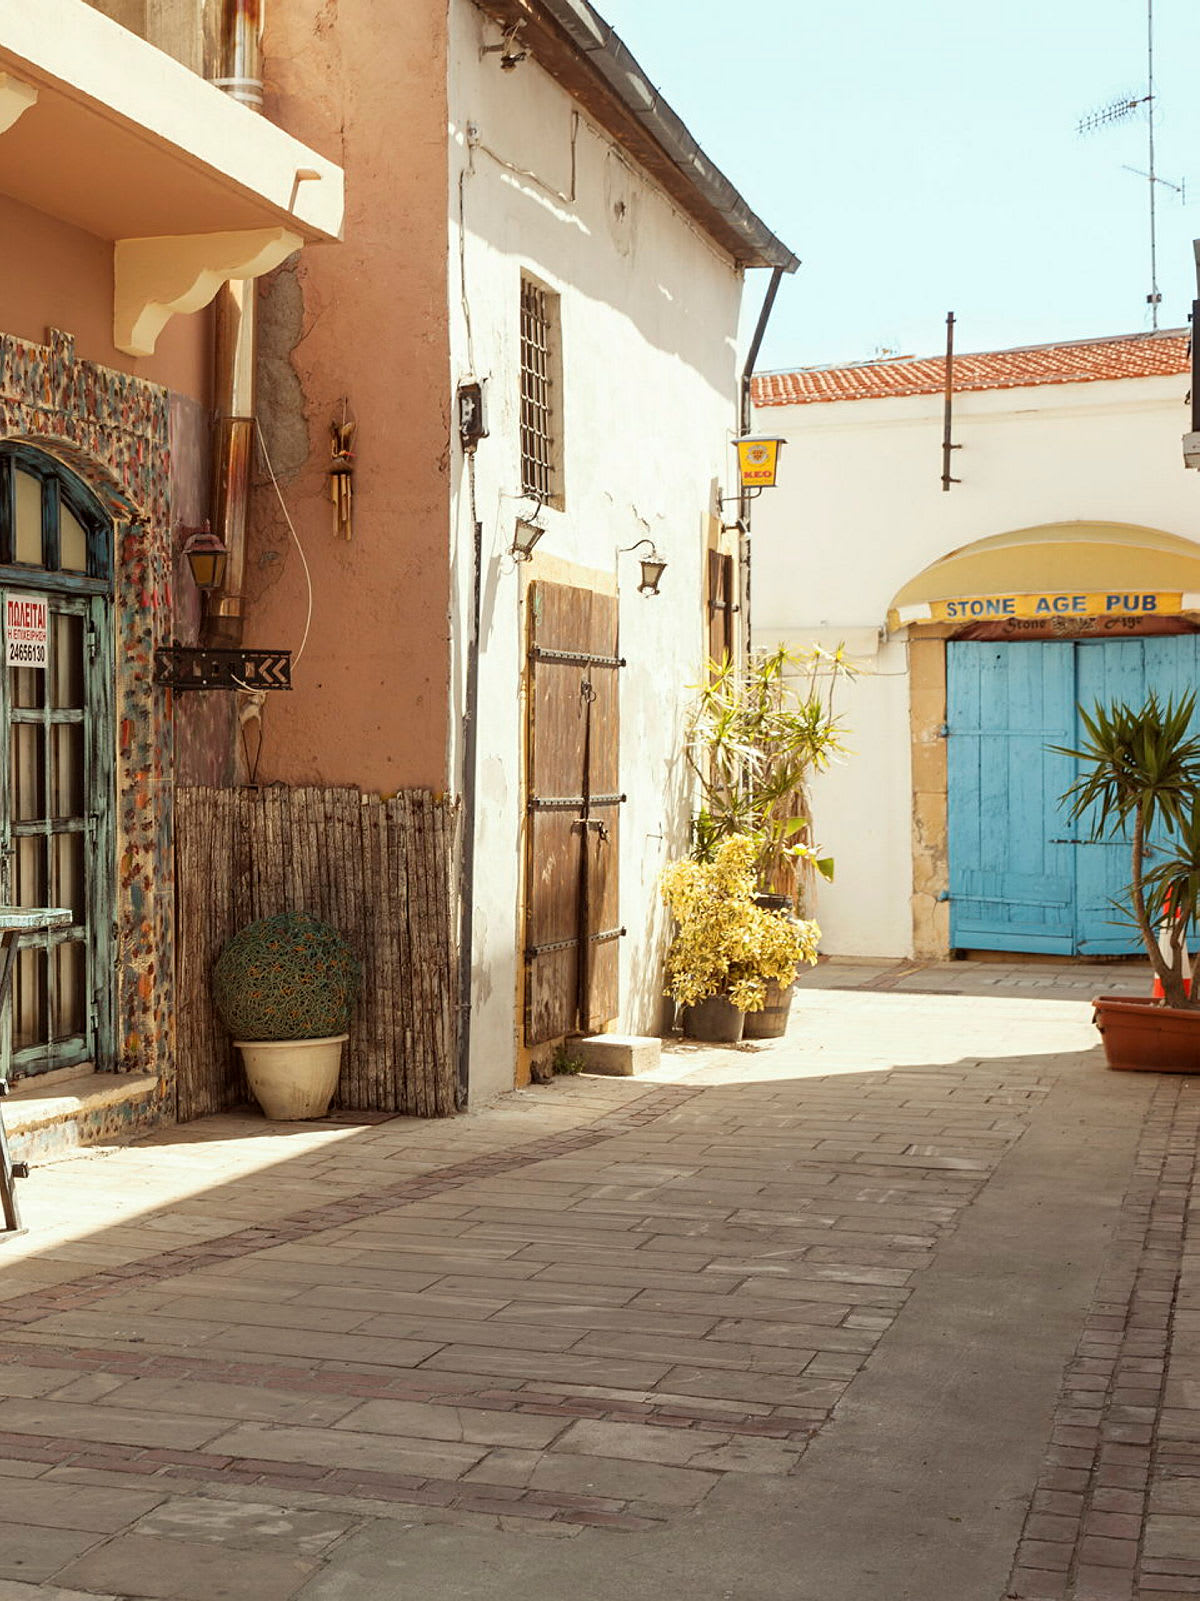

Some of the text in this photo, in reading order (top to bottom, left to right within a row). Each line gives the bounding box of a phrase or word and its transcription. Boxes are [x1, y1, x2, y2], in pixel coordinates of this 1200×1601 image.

[744, 470, 772, 478] KEO
[7, 600, 46, 629] ΠΩΛΕΙΤΑΙ
[947, 594, 1158, 617] STONE AGE PUB
[10, 643, 45, 662] 24656130
